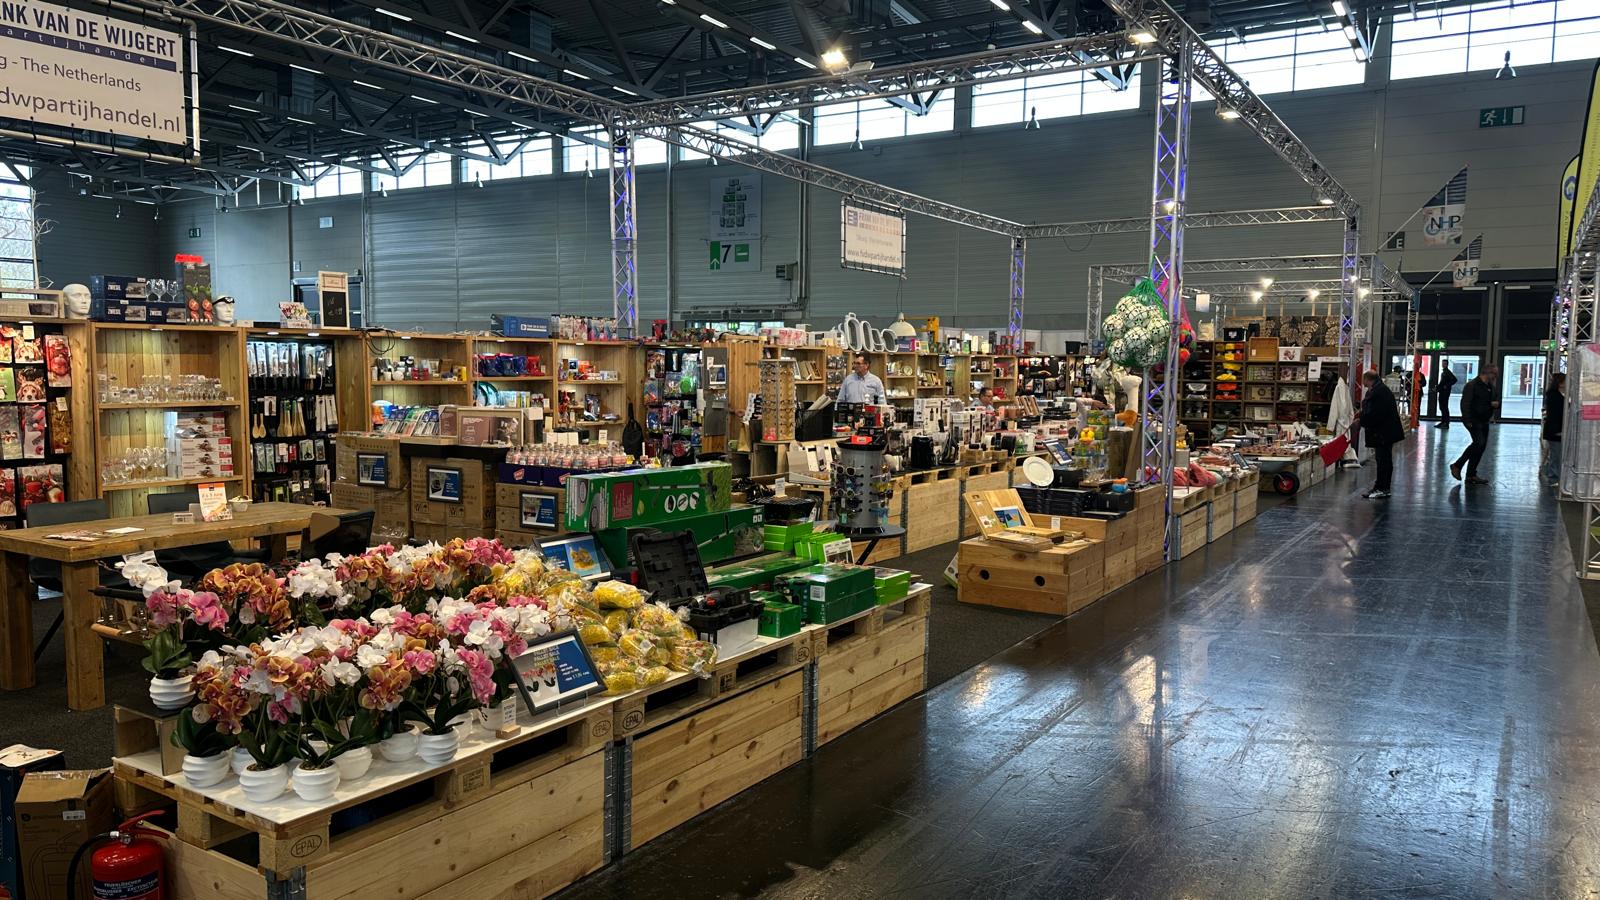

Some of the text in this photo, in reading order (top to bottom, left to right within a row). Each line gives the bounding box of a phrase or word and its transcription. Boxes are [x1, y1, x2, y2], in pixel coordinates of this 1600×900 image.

[0, 2, 176, 57] NK VAN DE WIJGERT
[20, 57, 50, 74] The
[54, 64, 142, 92] Netherlands
[1431, 215, 1461, 230] NHP
[1396, 238, 1403, 249] E
[721, 244, 732, 263] 7
[1457, 267, 1479, 277] NHP
[295, 839, 318, 855] EPAL
